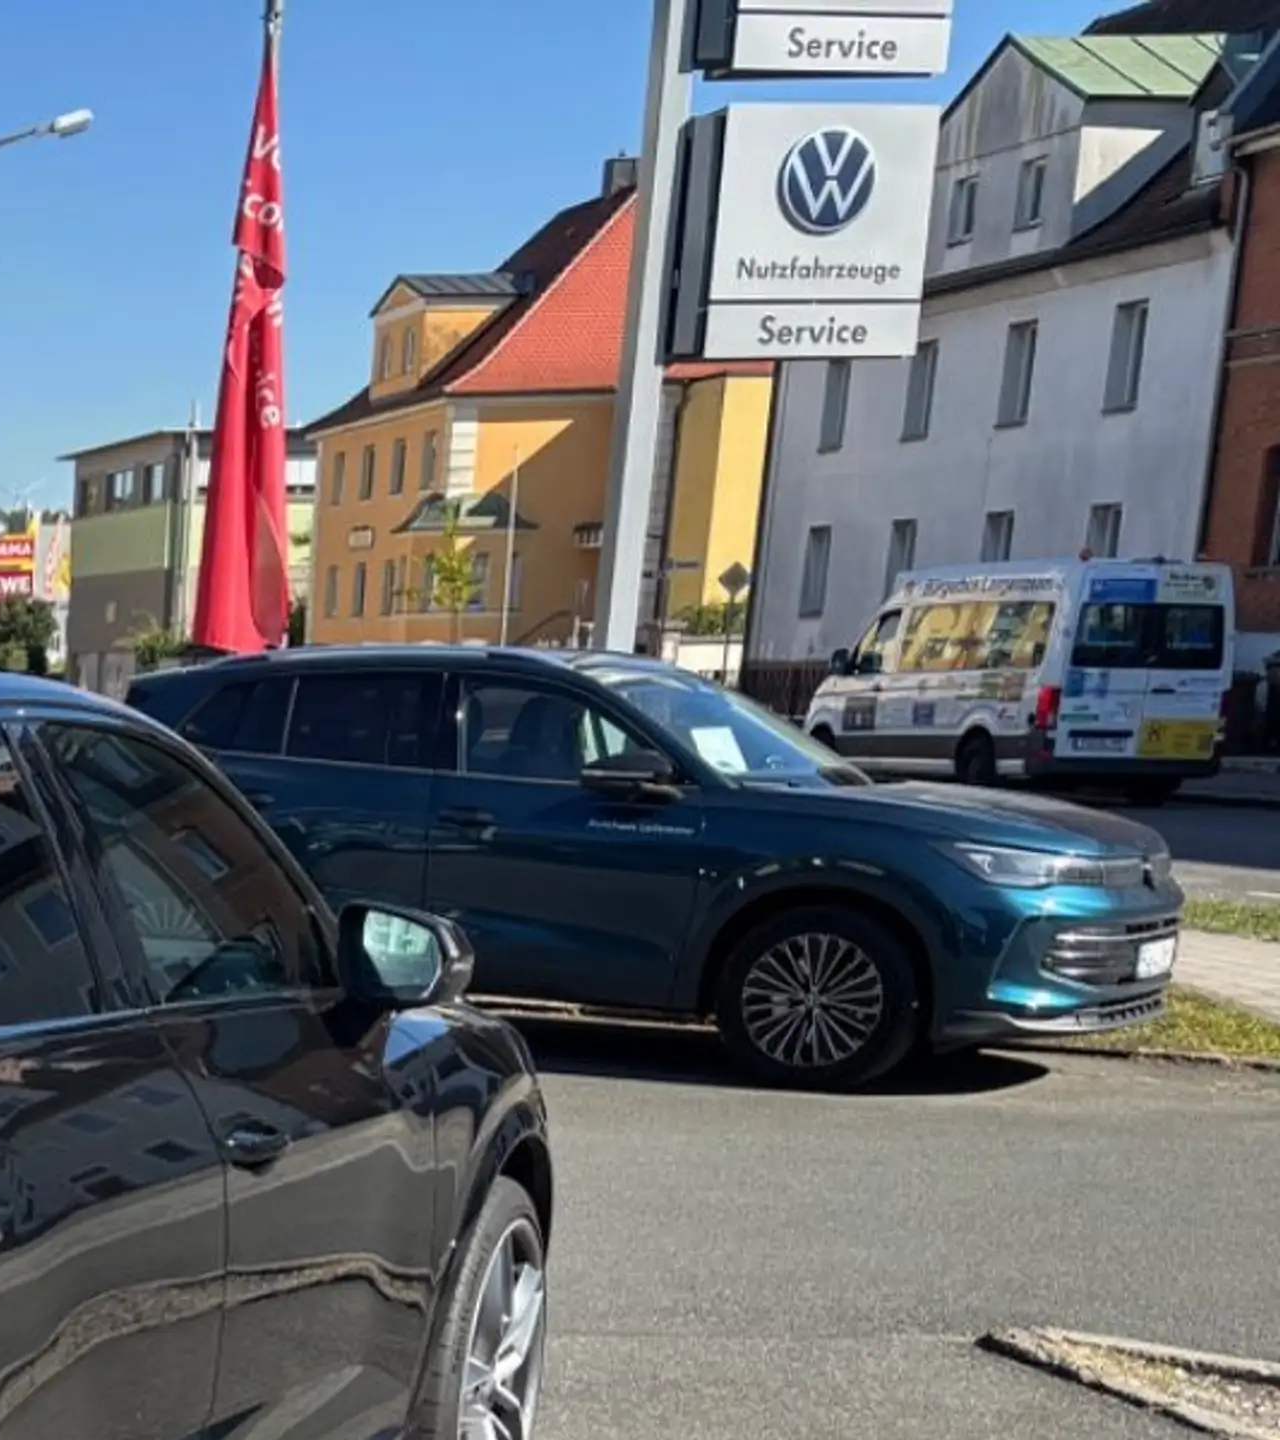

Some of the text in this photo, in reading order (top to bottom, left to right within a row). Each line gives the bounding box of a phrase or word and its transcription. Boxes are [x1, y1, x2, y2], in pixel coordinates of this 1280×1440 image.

[787, 26, 899, 61] Service
[736, 255, 903, 285] Nutzfahrzeuge
[756, 314, 869, 346] Service
